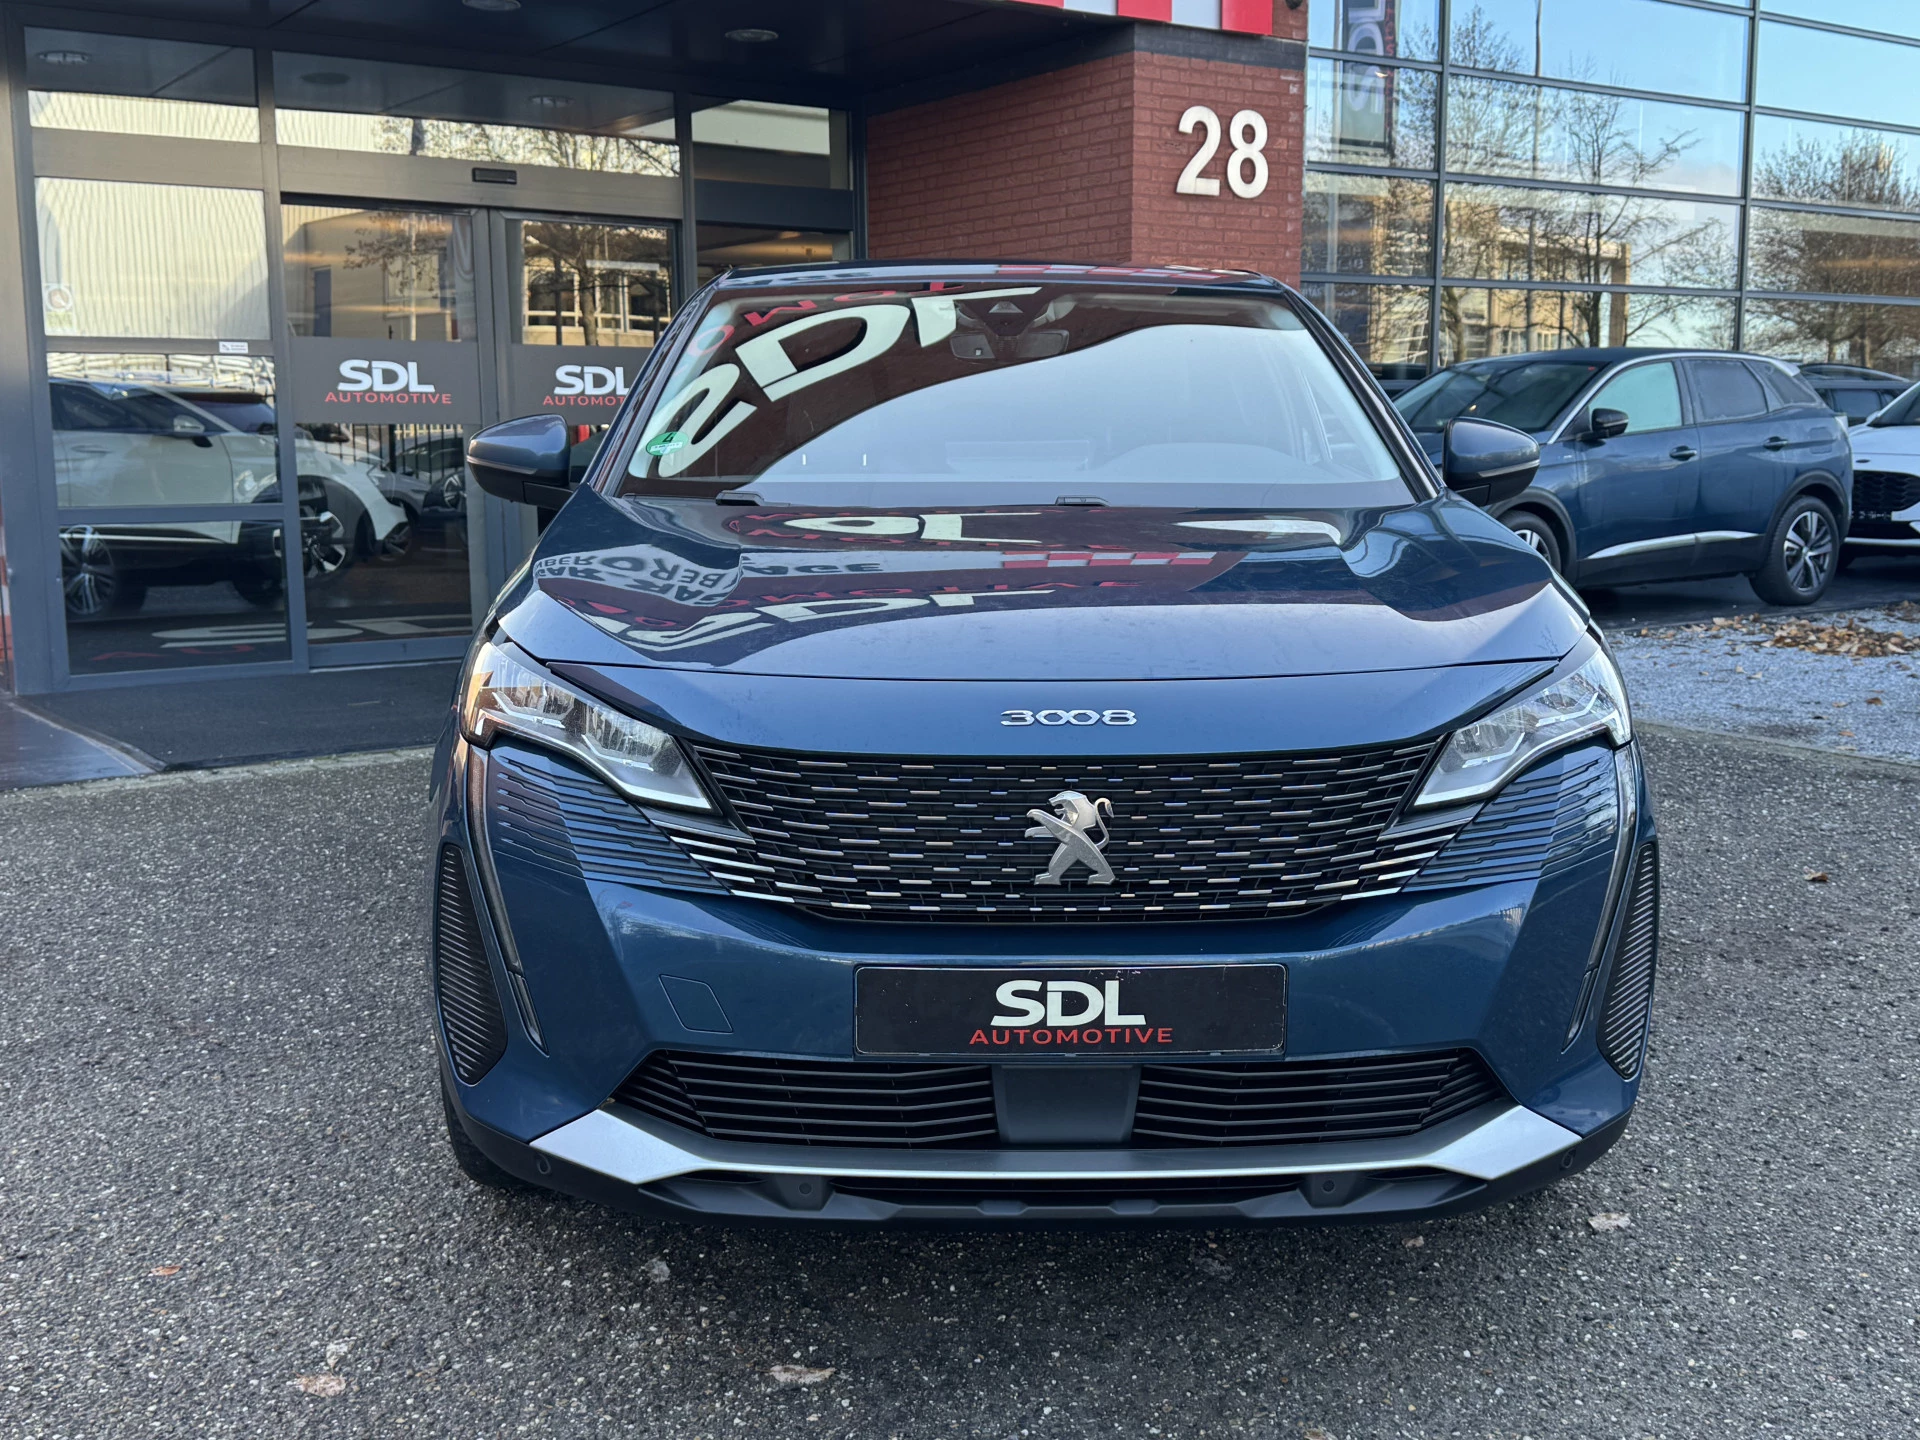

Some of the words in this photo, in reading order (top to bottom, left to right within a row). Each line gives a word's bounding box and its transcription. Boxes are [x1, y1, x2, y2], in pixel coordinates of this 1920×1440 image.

[1176, 105, 1269, 199] 28
[337, 359, 436, 393] SDL
[553, 364, 630, 396] SDL
[325, 391, 453, 405] AUTOMOTIVE
[543, 395, 627, 407] AUTOMOT
[1000, 709, 1138, 726] 3008
[990, 979, 1146, 1027] SDL
[968, 1027, 1173, 1046] AUTOMOTIVE
